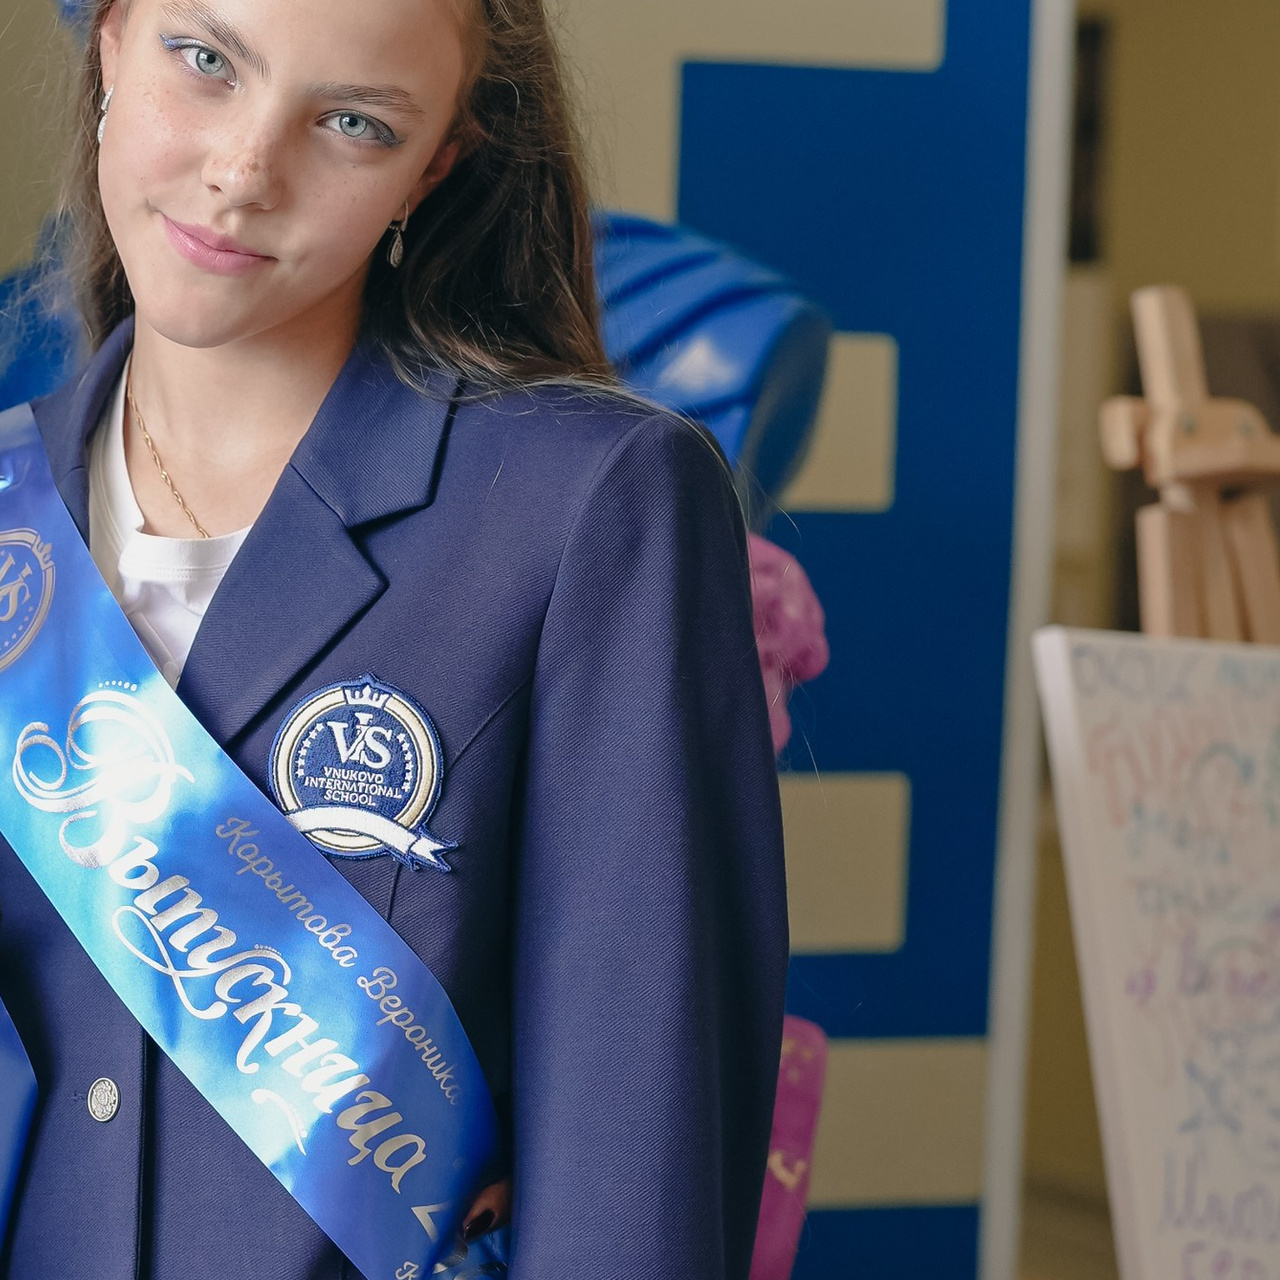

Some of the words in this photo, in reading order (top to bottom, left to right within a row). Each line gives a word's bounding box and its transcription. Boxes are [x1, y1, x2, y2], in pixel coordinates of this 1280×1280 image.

[323, 766, 384, 784] VNUKOVO
[303, 776, 403, 799] INTERNATIONAL
[323, 789, 376, 806] SCHOOL
[215, 816, 359, 968] Корытова
[11, 678, 428, 1195] Выпускница
